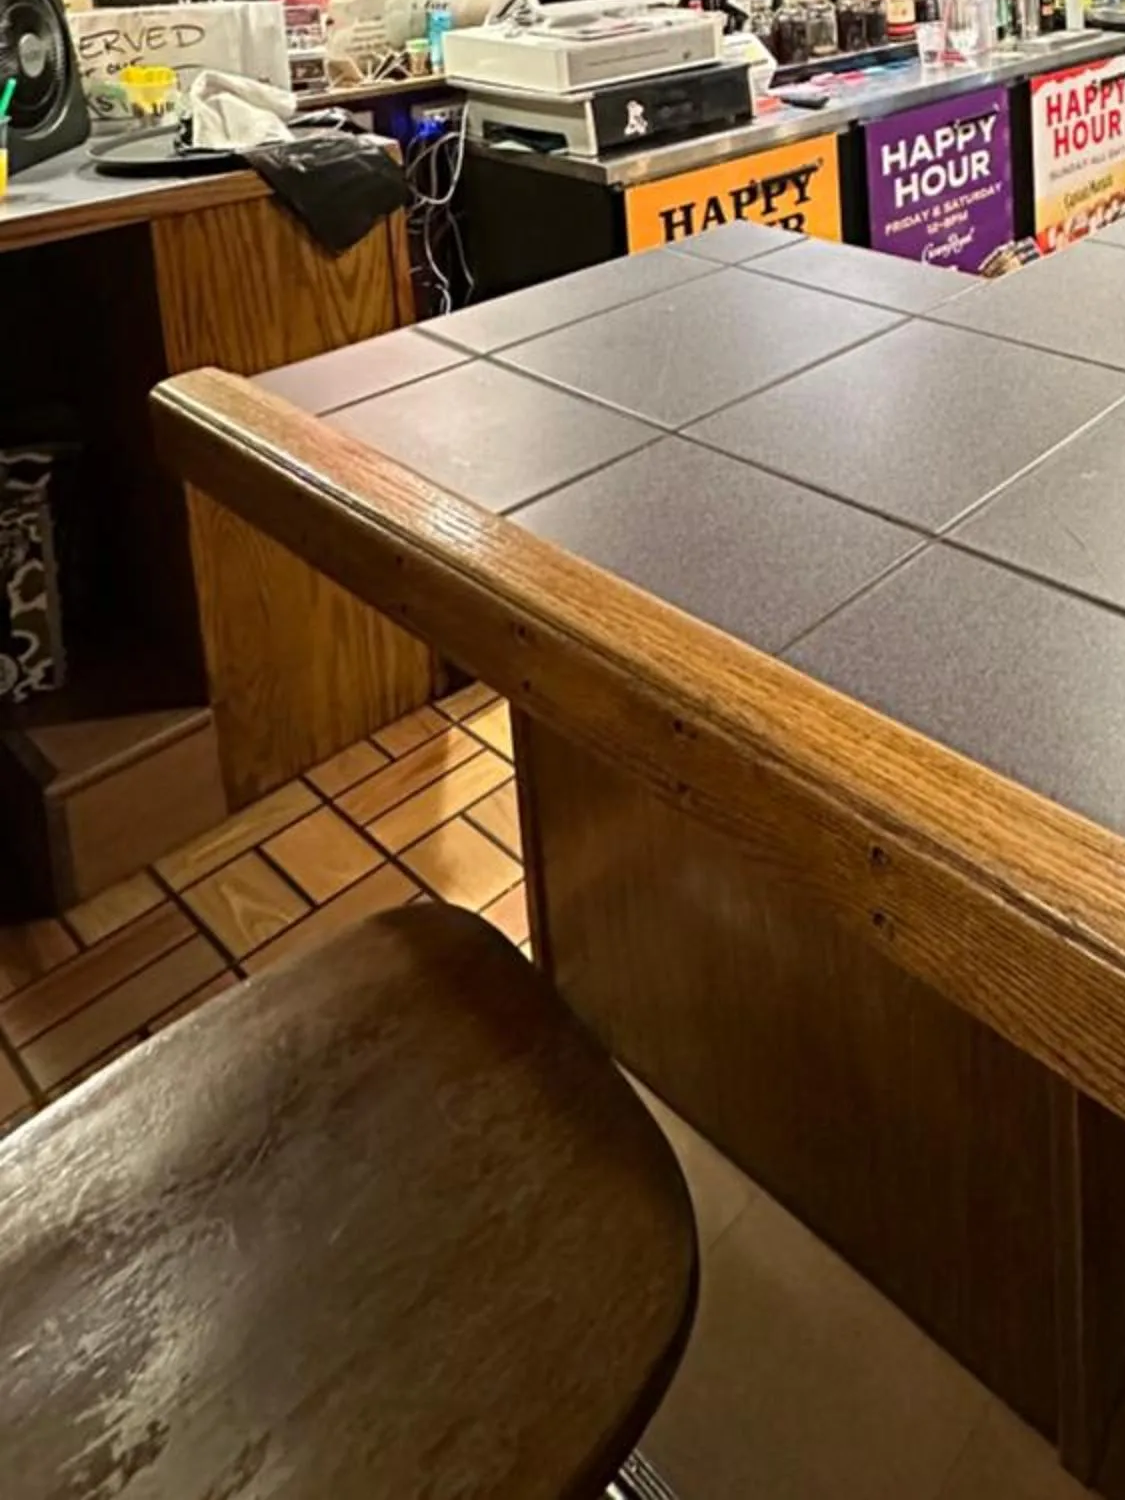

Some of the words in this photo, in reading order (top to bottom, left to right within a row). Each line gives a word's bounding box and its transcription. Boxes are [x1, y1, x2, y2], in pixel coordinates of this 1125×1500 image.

[79, 23, 206, 61] ERVED
[881, 114, 997, 176] HAPPY
[1053, 108, 1122, 160] HOUR
[658, 163, 818, 243] HAPPY
[894, 150, 990, 209] HOUR
[884, 208, 930, 236] FRIDAY
[943, 181, 1002, 213] SATURDAY
